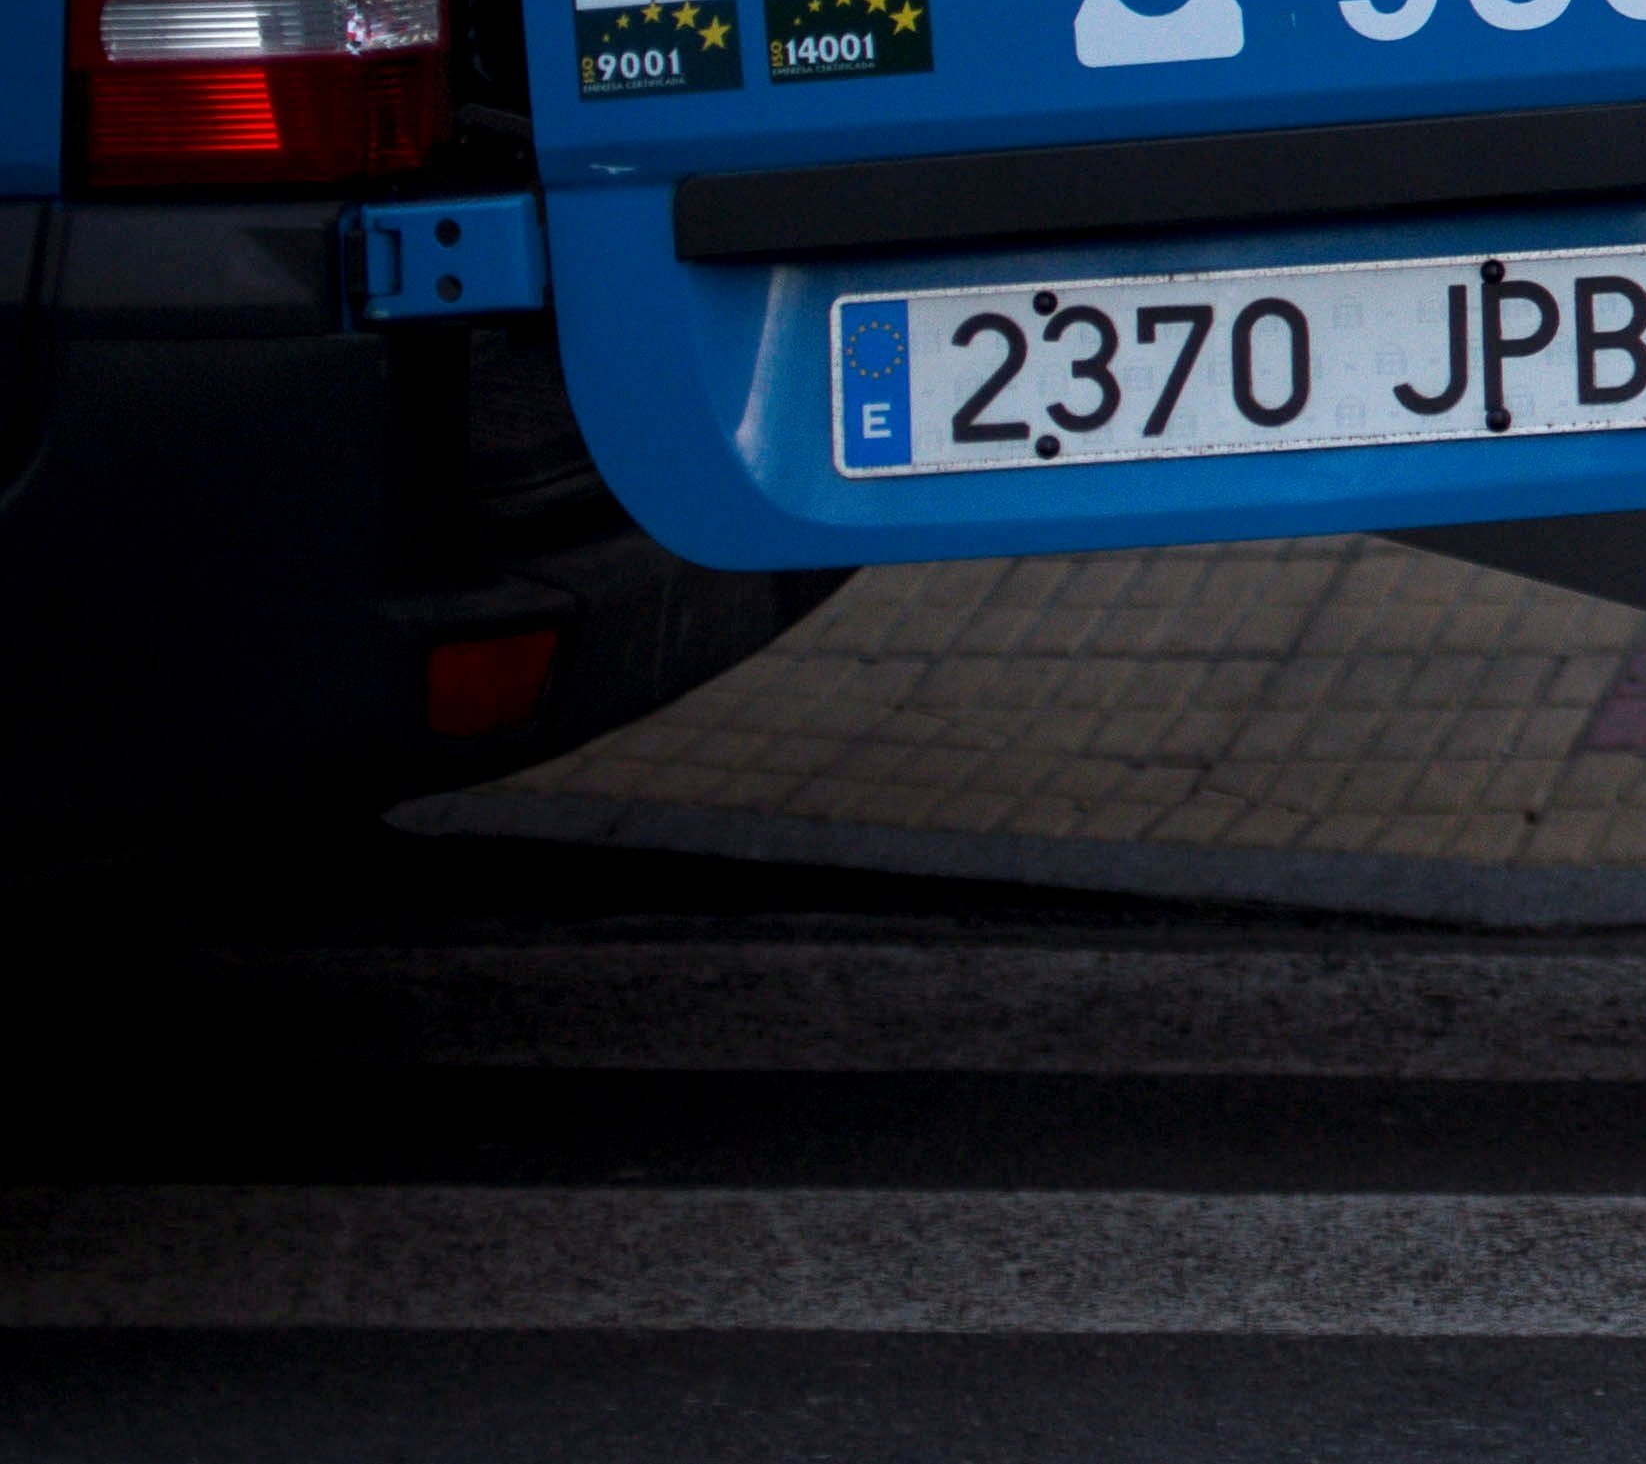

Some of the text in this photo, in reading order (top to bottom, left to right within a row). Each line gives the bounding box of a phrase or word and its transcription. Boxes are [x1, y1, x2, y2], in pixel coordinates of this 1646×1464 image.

[597, 47, 682, 81] 9001
[785, 31, 876, 65] 14001
[951, 297, 1311, 443] 2370
[862, 403, 892, 439] E
